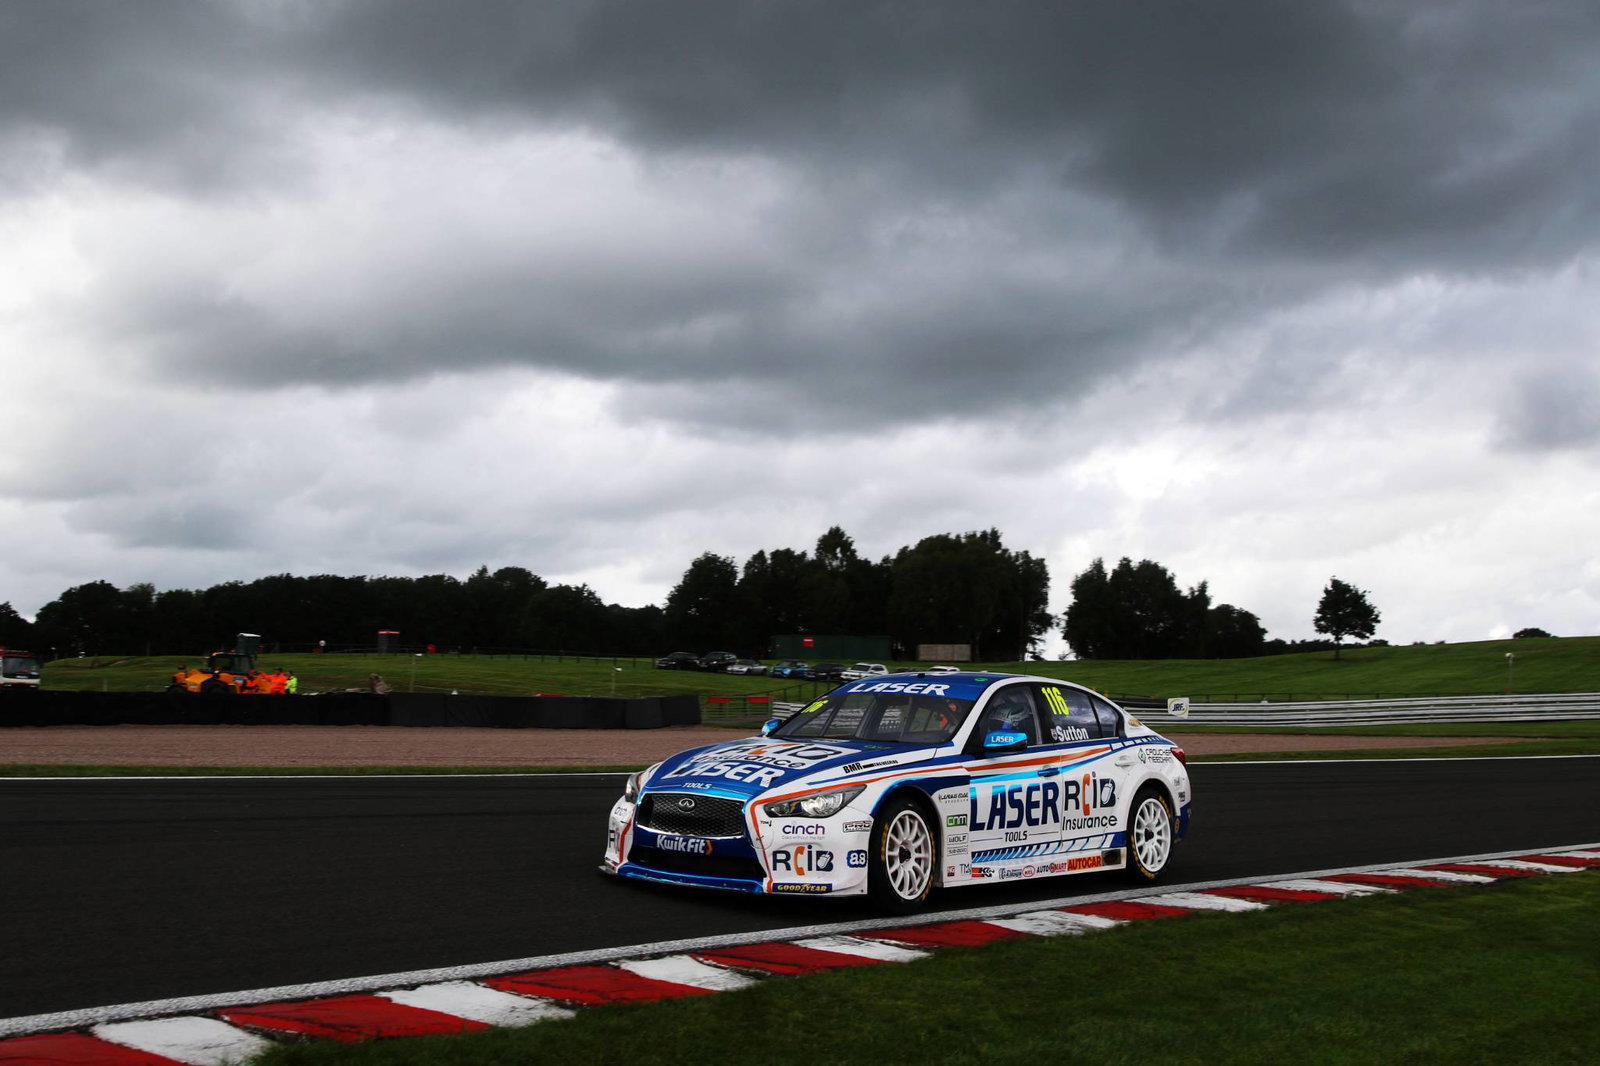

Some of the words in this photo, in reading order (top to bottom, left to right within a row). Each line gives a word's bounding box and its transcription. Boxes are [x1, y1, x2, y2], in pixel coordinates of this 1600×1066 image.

[848, 682, 950, 696] LASER
[1041, 686, 1070, 716] 116
[1055, 725, 1089, 742] Sutton
[661, 761, 786, 788] LASER
[842, 762, 863, 774] BMR
[682, 782, 712, 790] TOOLS
[969, 781, 1060, 832] LASER
[782, 824, 825, 835] cinch
[1062, 814, 1118, 832] Insurance
[1004, 830, 1028, 842] TOOLS
[1067, 856, 1102, 871] AUTOCAR
[777, 884, 828, 893] GOODYEAR
